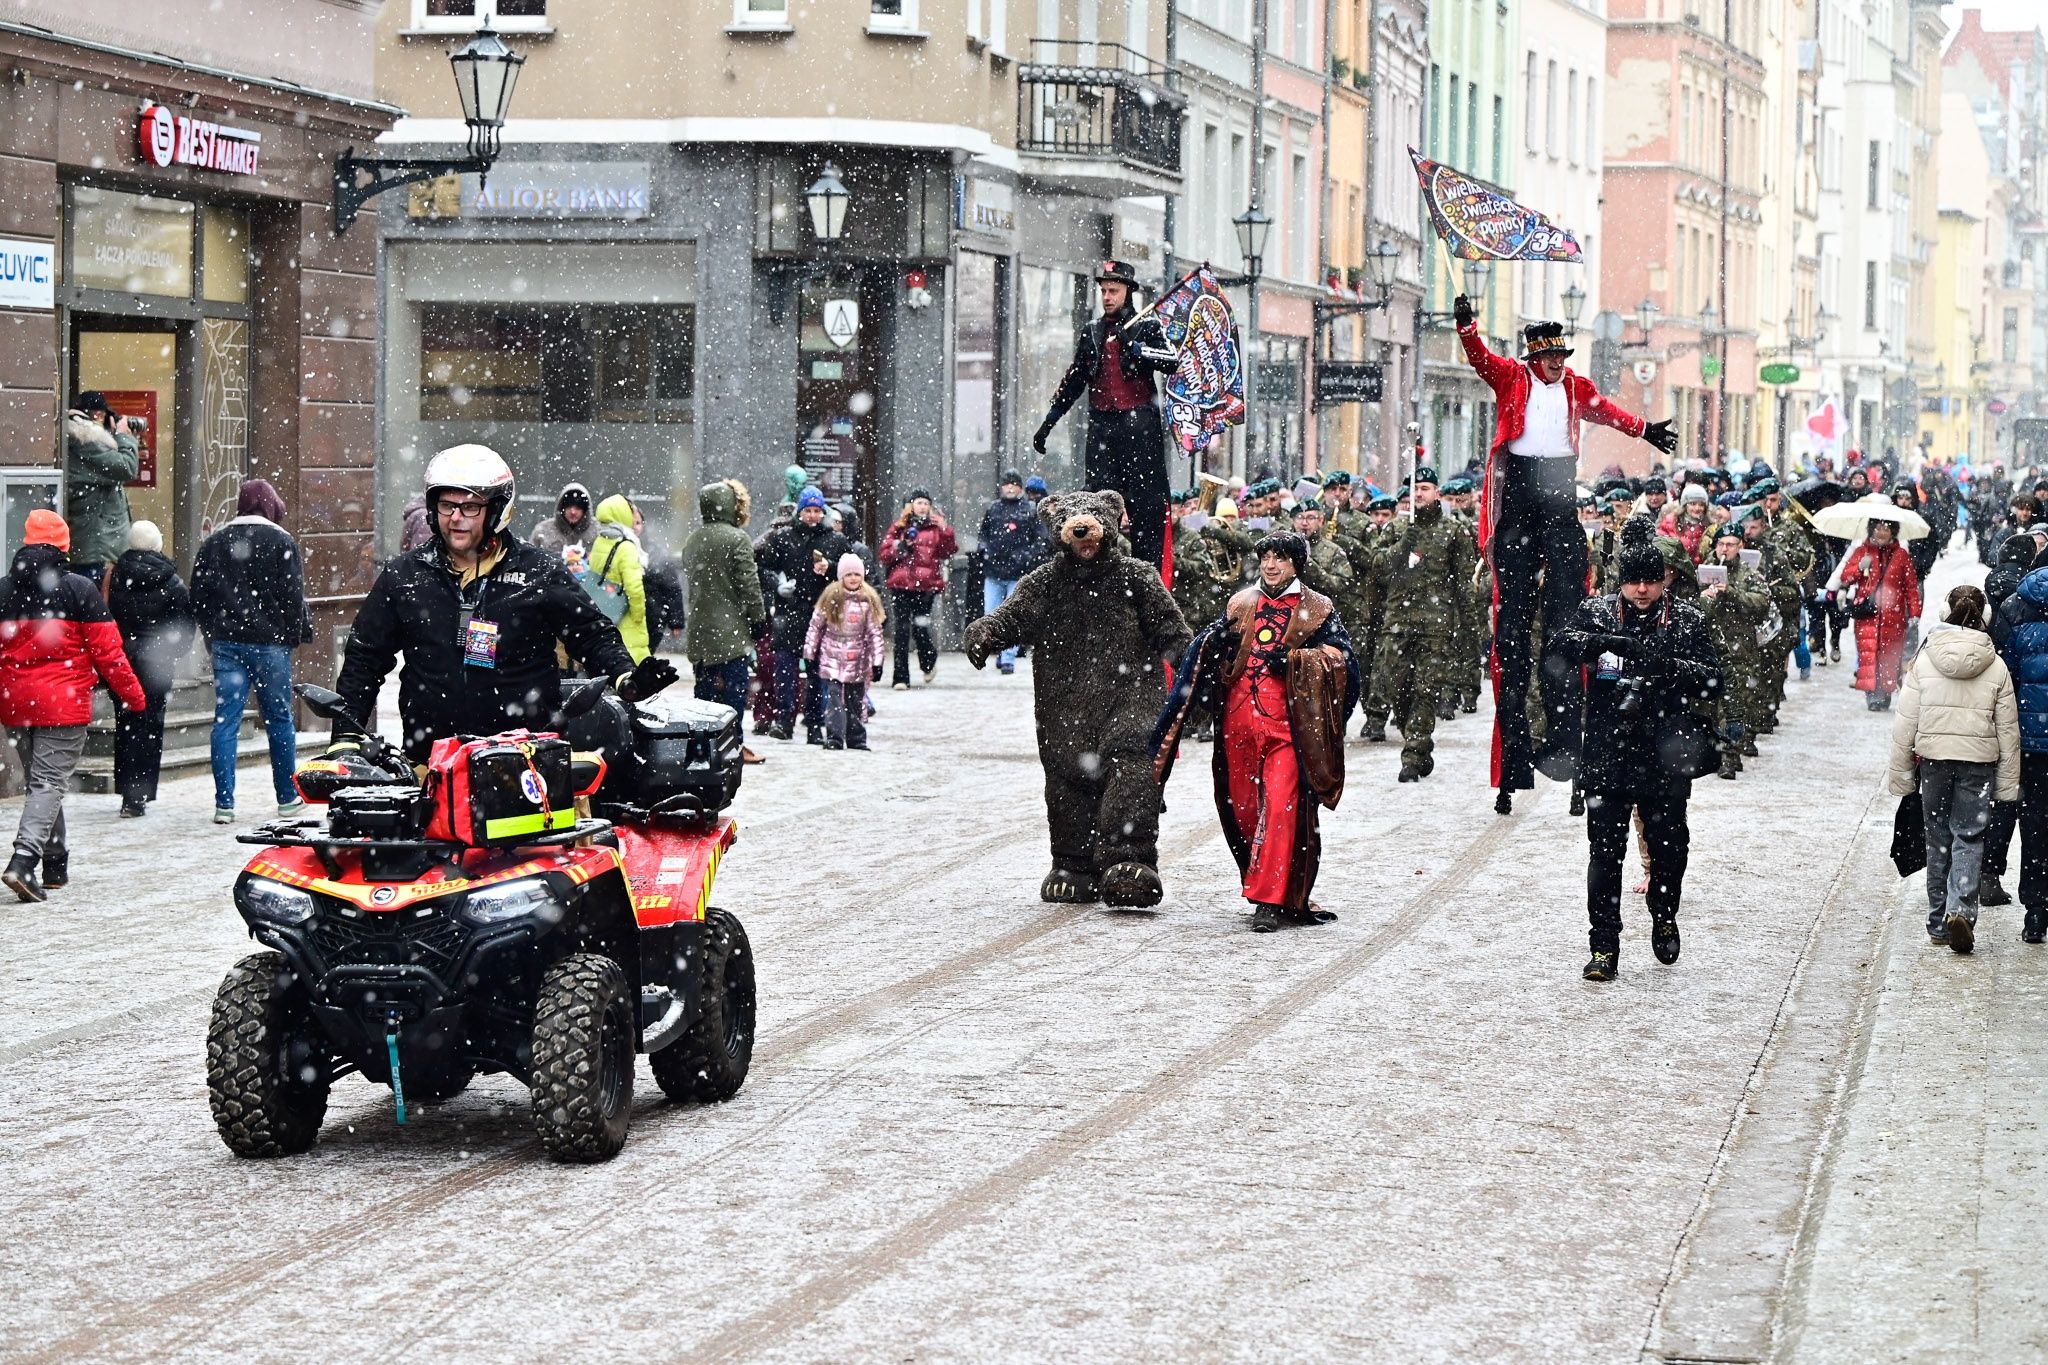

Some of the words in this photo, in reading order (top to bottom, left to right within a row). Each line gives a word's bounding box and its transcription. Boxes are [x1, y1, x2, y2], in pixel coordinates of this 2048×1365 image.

[178, 116, 218, 168] BEST
[216, 138, 260, 175] MARKET
[475, 187, 562, 209] ALIOR
[569, 186, 642, 210] BANK
[1444, 180, 1483, 200] wielka
[1480, 217, 1526, 239] pomocy
[1532, 231, 1563, 253] 34
[1201, 307, 1222, 345] wielka
[1181, 350, 1203, 396] pomocy
[1172, 403, 1202, 439] 34
[391, 1066, 404, 1106] CFMOTO
